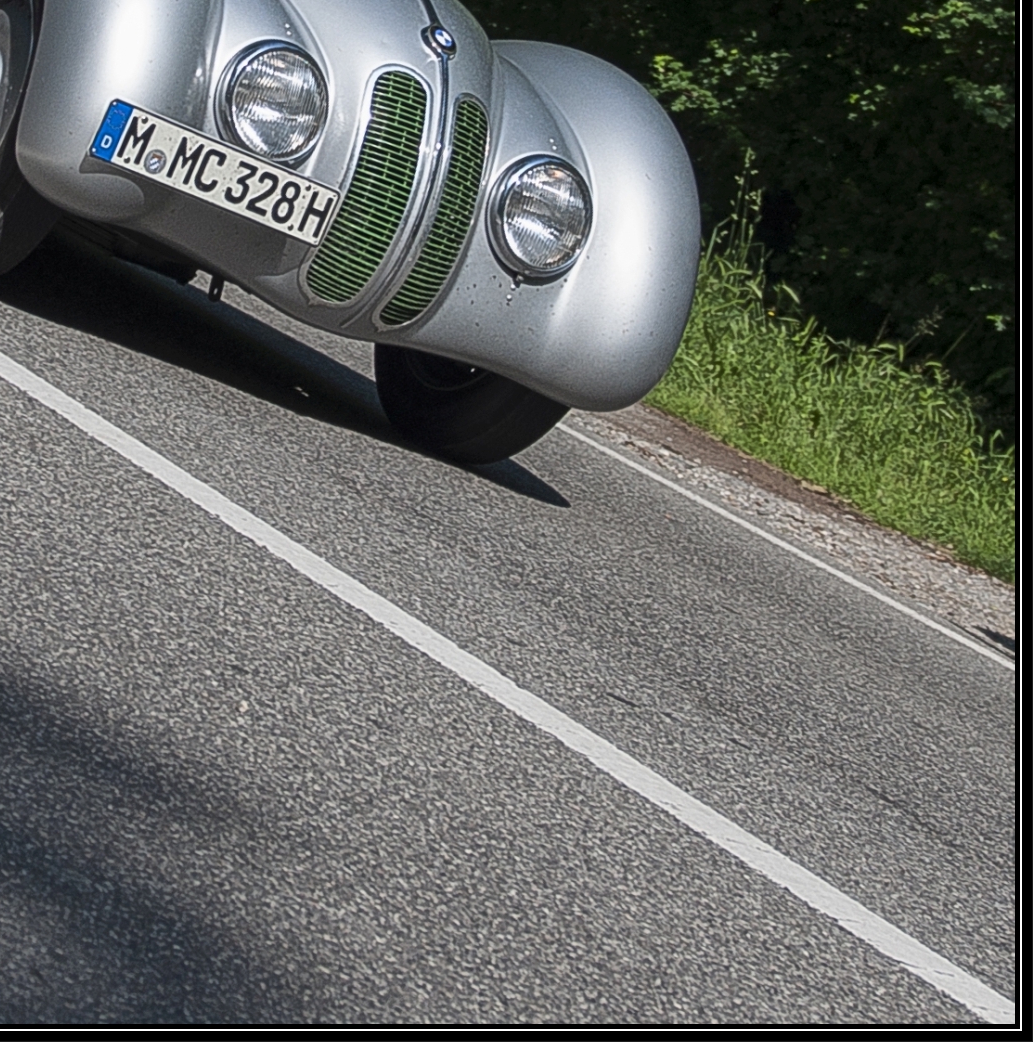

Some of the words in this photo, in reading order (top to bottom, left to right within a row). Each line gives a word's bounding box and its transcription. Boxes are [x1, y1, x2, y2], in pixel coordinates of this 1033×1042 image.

[100, 135, 113, 149] D
[116, 115, 157, 166] M
[166, 136, 228, 193] MC
